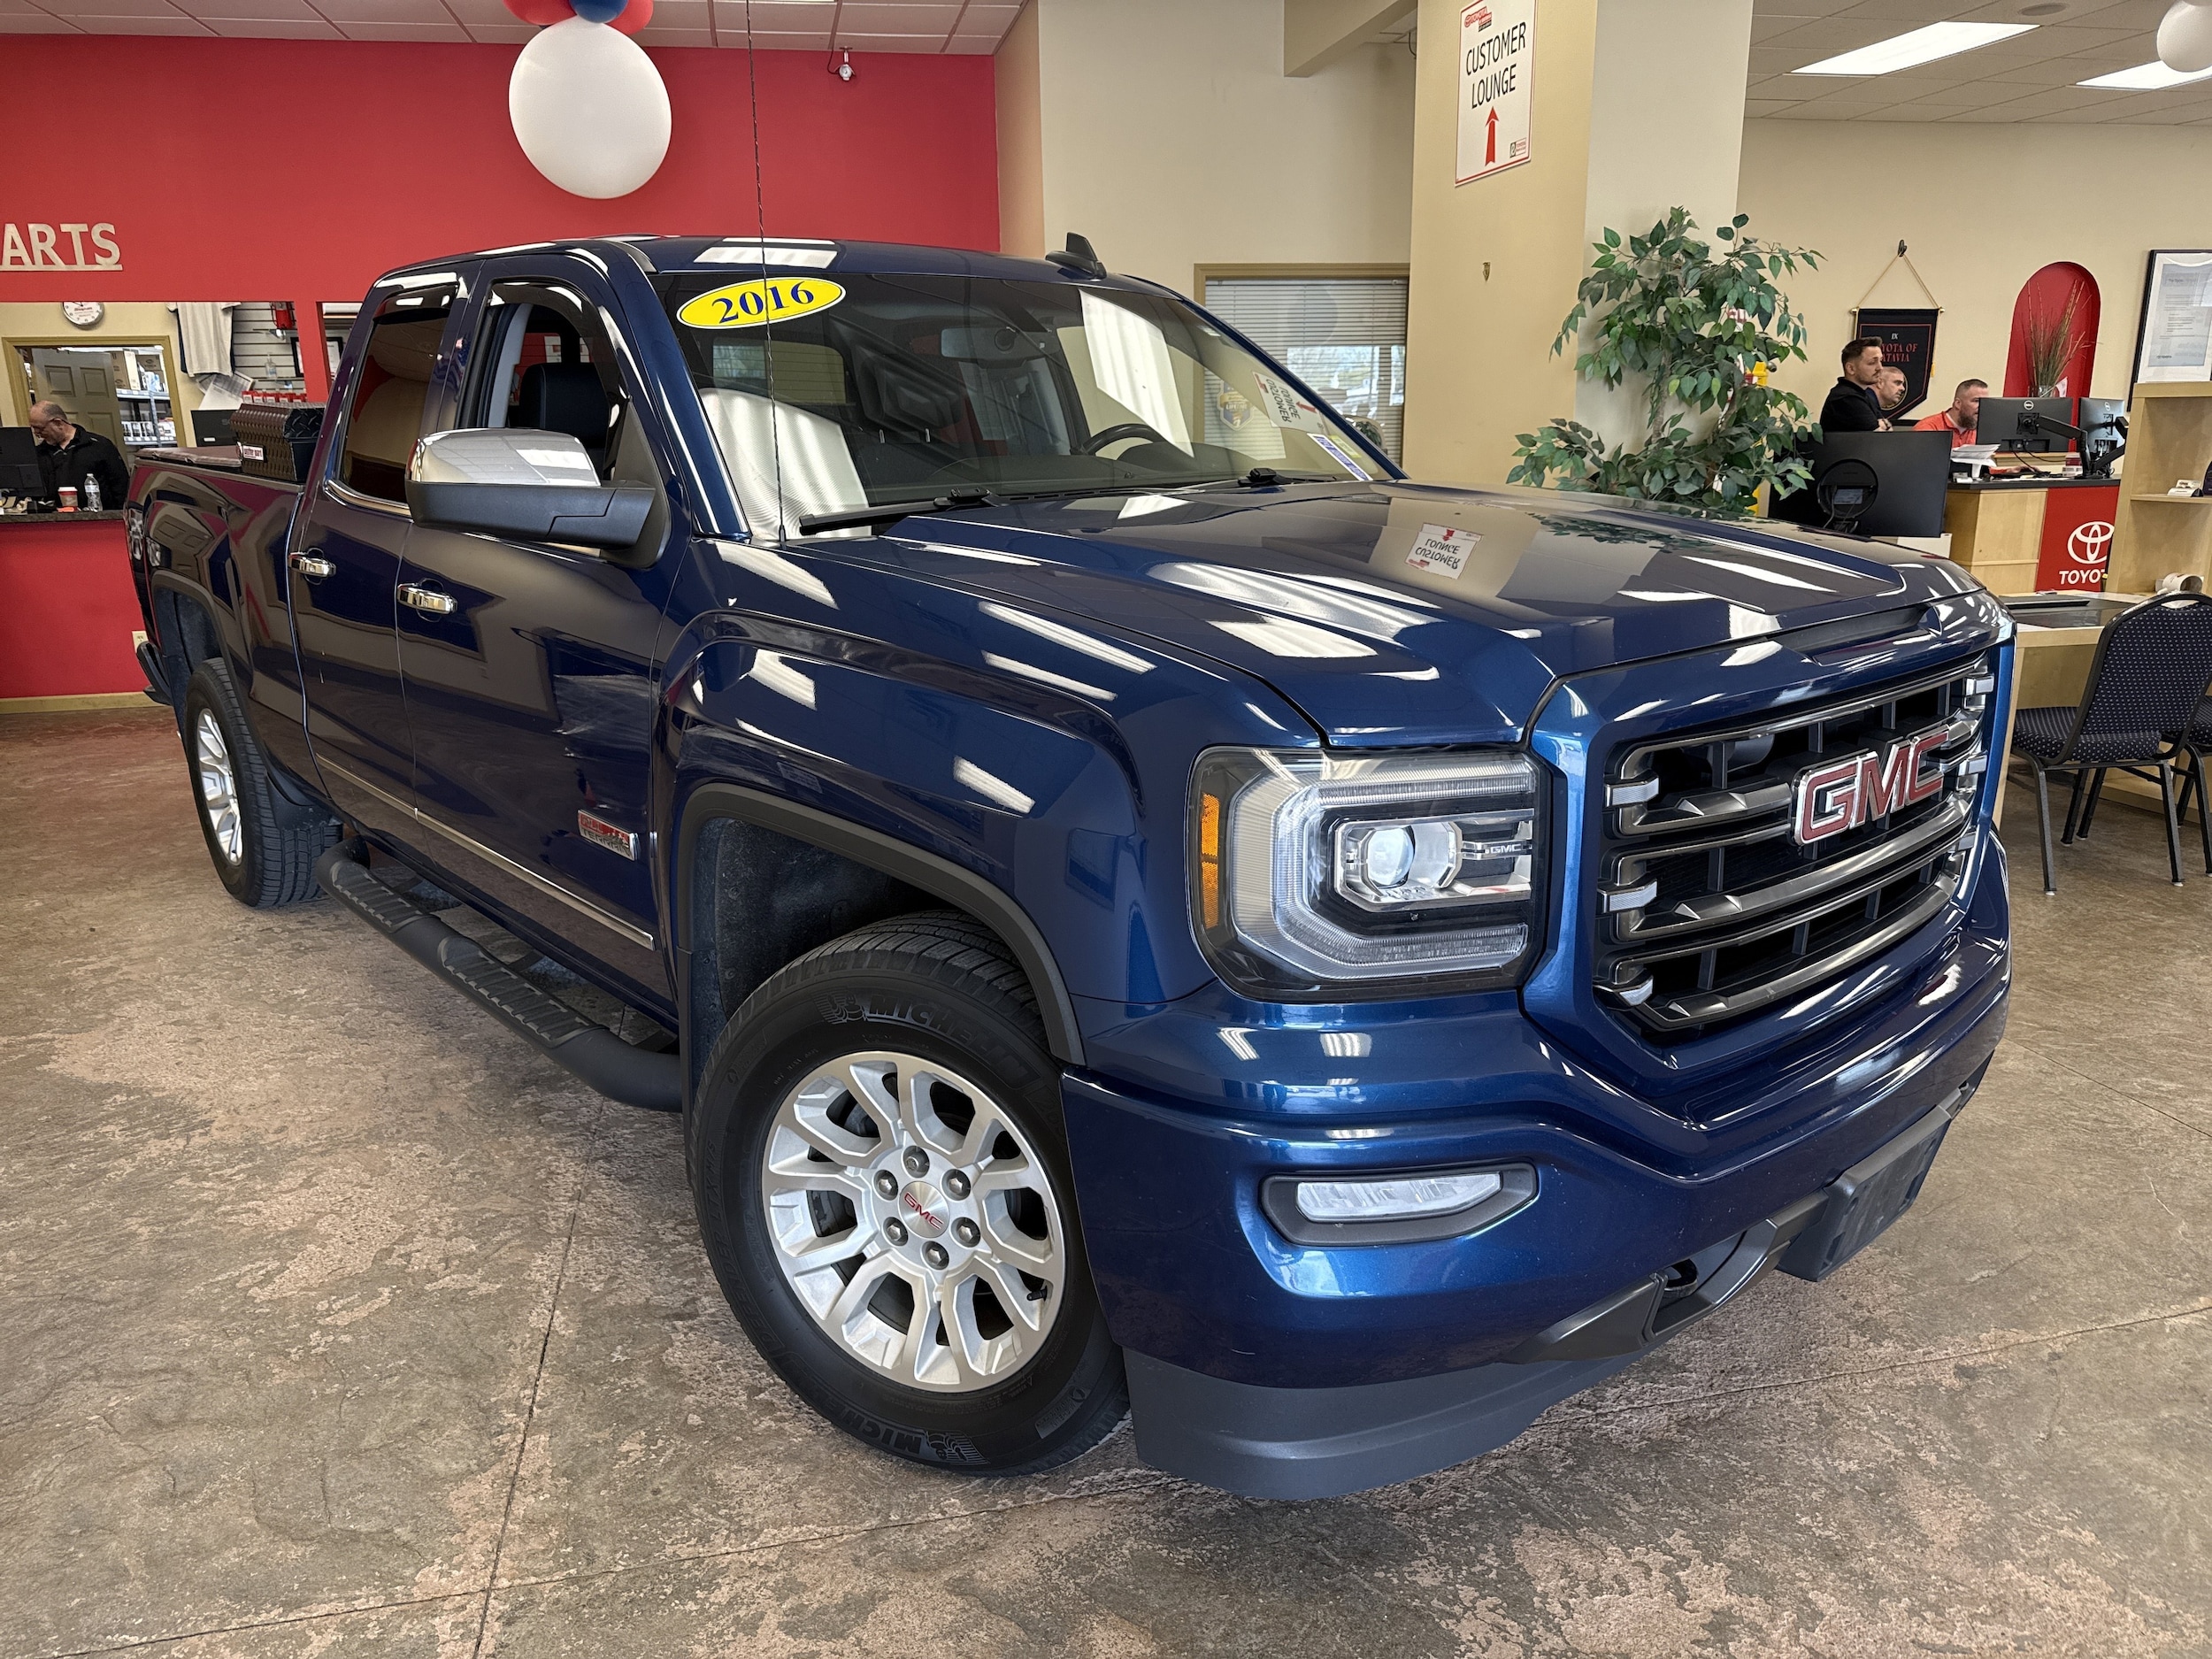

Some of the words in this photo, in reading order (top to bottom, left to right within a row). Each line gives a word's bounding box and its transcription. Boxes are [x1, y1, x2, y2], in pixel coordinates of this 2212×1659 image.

[1466, 21, 1526, 76] CUSTOMER
[1471, 64, 1517, 109] LOUNGE
[2, 223, 121, 265] ARTS
[711, 280, 815, 324] 2016
[1881, 343, 1903, 353] YOTA
[1906, 343, 1918, 353] OF
[1882, 353, 1909, 362] ATAVIA
[2059, 569, 2105, 585] TOYO
[1793, 733, 1948, 847] GMC
[1490, 843, 1522, 854] GMC
[904, 1191, 944, 1230] GMC
